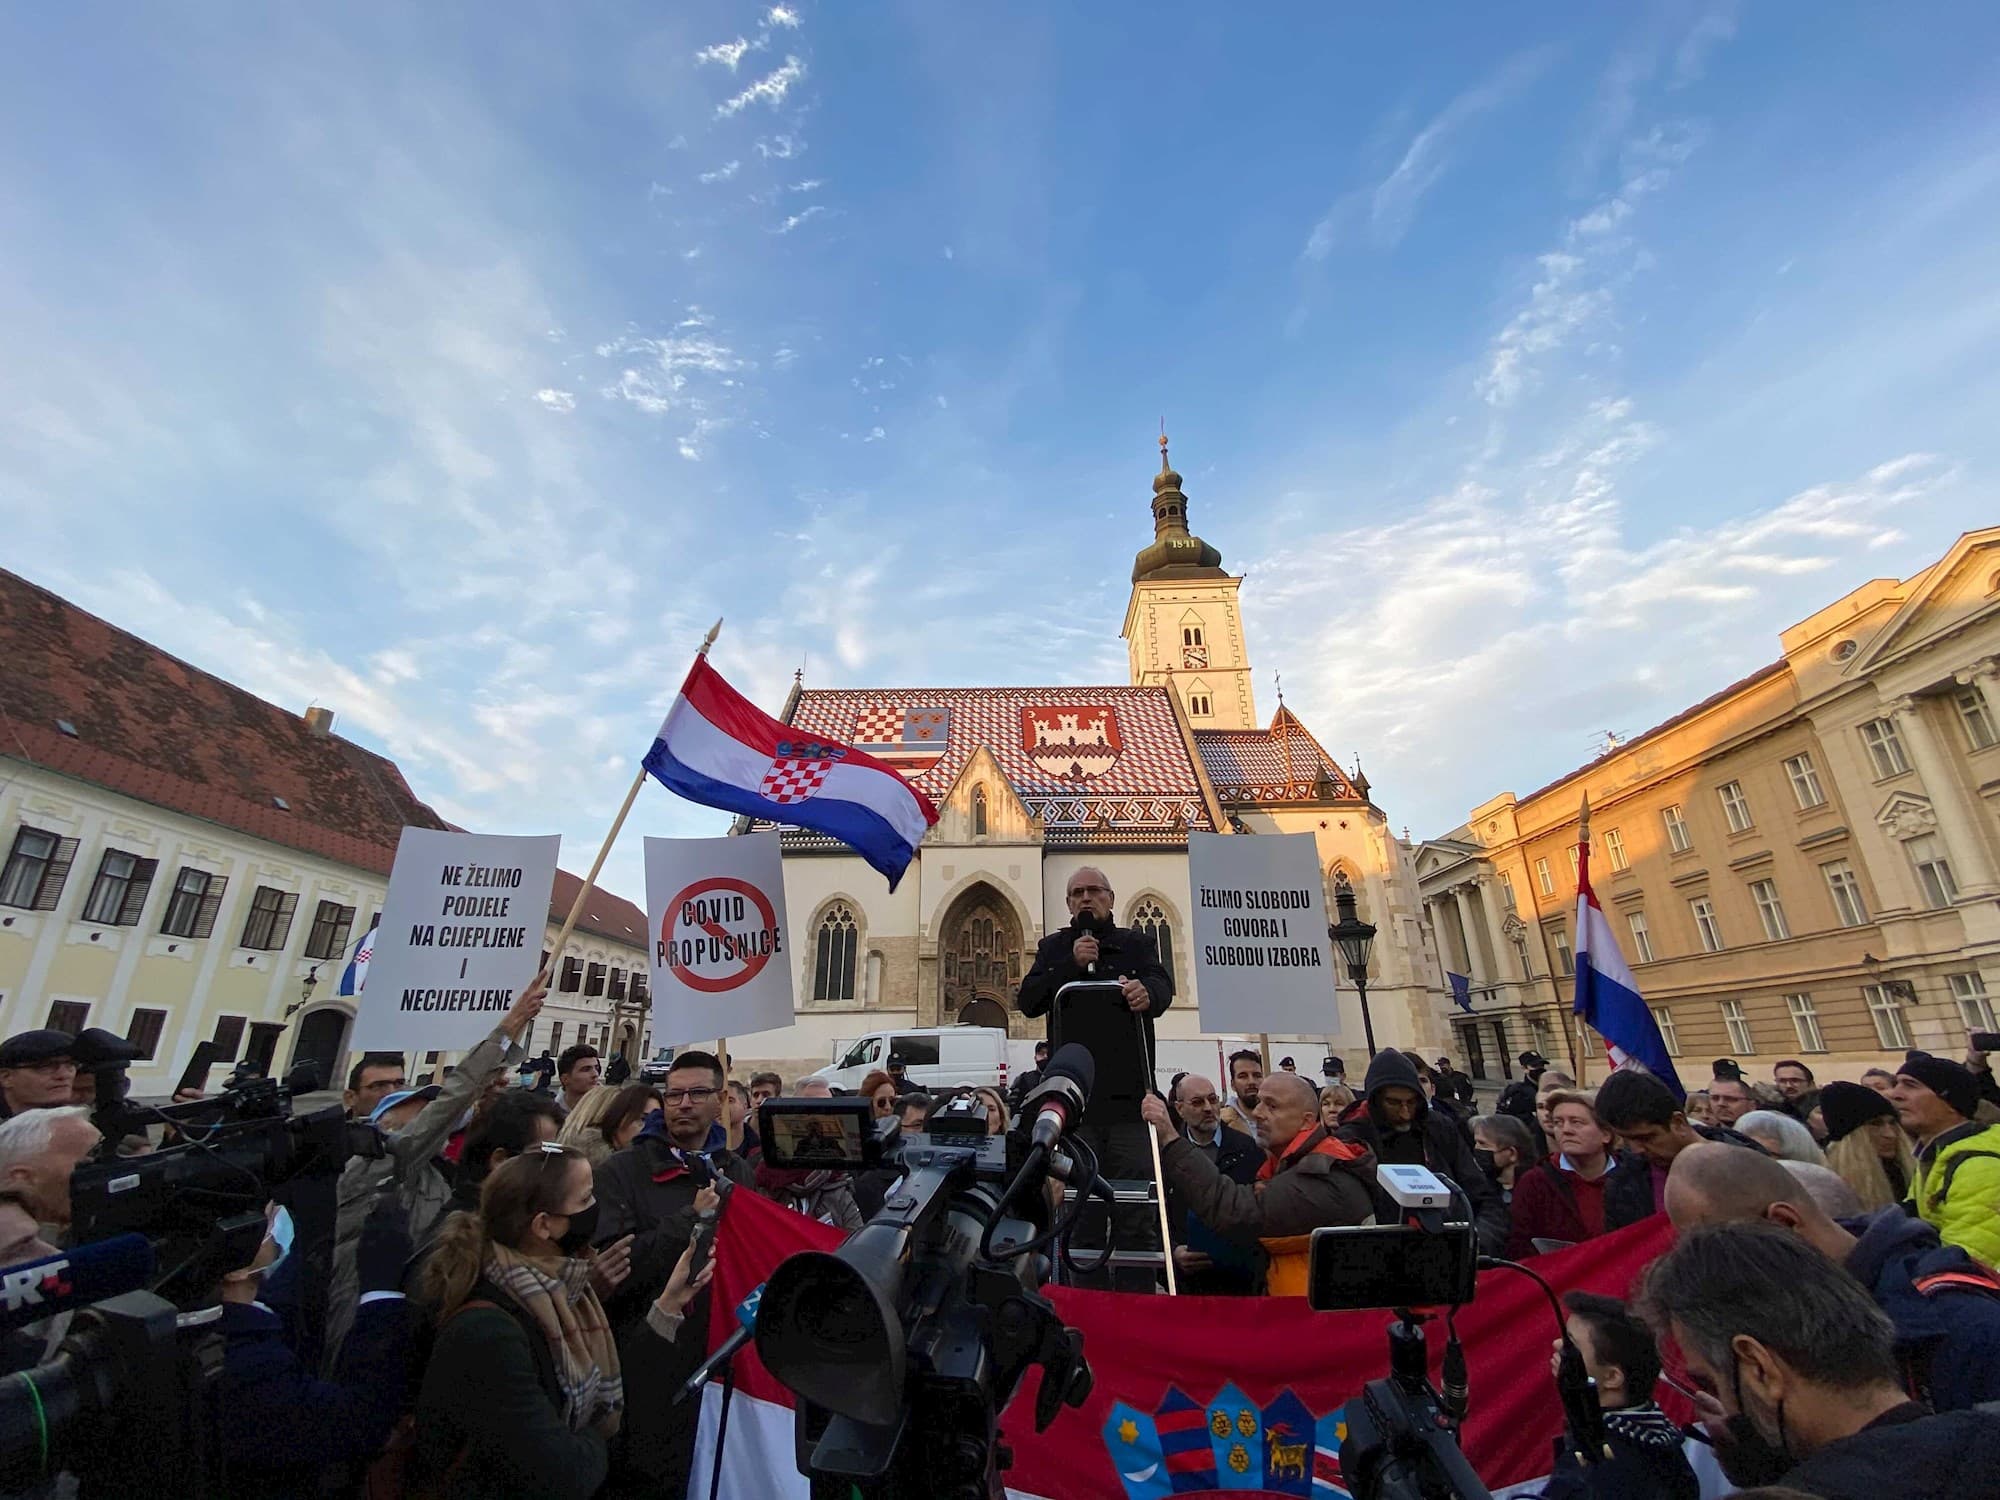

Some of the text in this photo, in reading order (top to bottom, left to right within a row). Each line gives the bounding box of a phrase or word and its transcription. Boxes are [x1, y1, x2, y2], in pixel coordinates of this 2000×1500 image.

[441, 862, 522, 888] NE ŽELIMO
[442, 896, 510, 917] PODJELE
[1200, 885, 1310, 909] ŽELIMO SLOBODU
[682, 896, 745, 927] COVID
[409, 925, 526, 948] NA CIJEPLJENE
[1223, 917, 1288, 938] GOVORA I
[657, 927, 782, 968] PROPUSNICE
[1205, 945, 1321, 967] SLOBODU IZBORA
[459, 958, 468, 979] I
[400, 989, 513, 1011] NECIJEPLJENE
